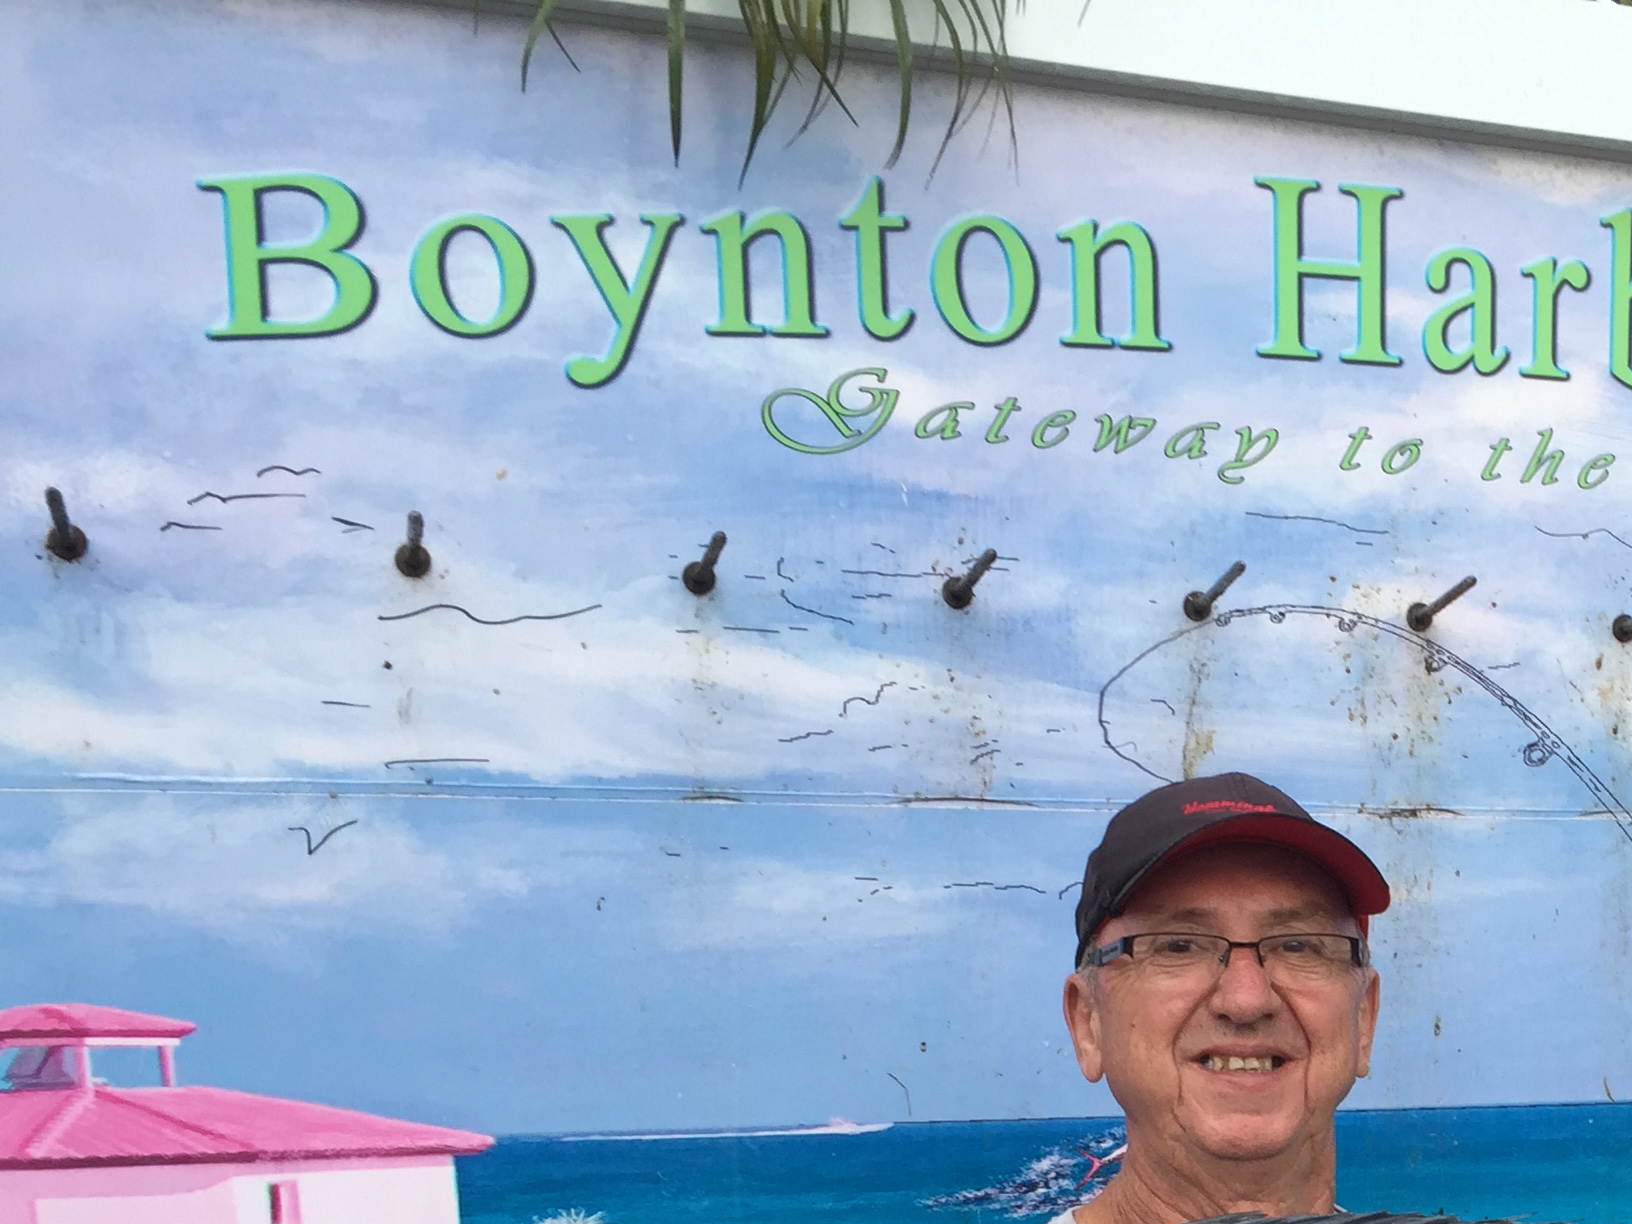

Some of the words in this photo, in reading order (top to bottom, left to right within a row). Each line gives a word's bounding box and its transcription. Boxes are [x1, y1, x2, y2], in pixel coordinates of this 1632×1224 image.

[198, 171, 1173, 387] Boynton
[762, 366, 1279, 485] Gateway
[1340, 425, 1421, 475] to
[1481, 429, 1616, 490] the
